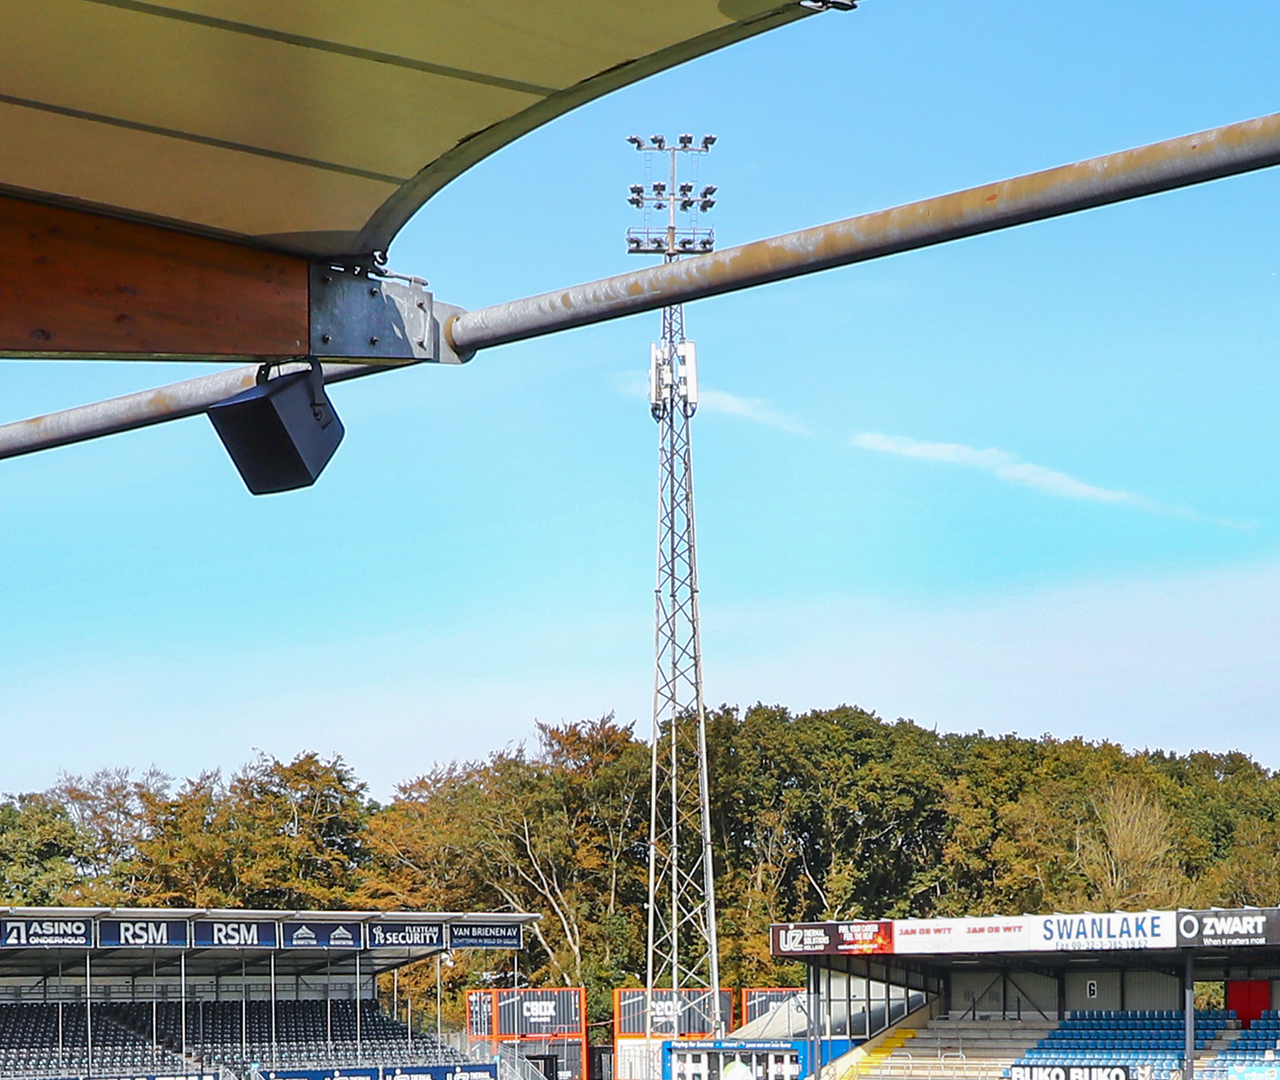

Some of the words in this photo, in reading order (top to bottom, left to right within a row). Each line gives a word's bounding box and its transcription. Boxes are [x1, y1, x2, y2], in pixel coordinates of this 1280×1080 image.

[28, 921, 87, 935] ASINO
[119, 923, 169, 945] RSM
[452, 927, 470, 937] VAN
[471, 926, 506, 937] BRIENEN
[1043, 916, 1161, 941] SWANLAKE
[1202, 915, 1267, 936] ZWART
[28, 936, 88, 945] ONDERHOUD
[213, 924, 260, 945] RSM
[385, 932, 440, 945] SECURITY
[1088, 981, 1097, 998] G
